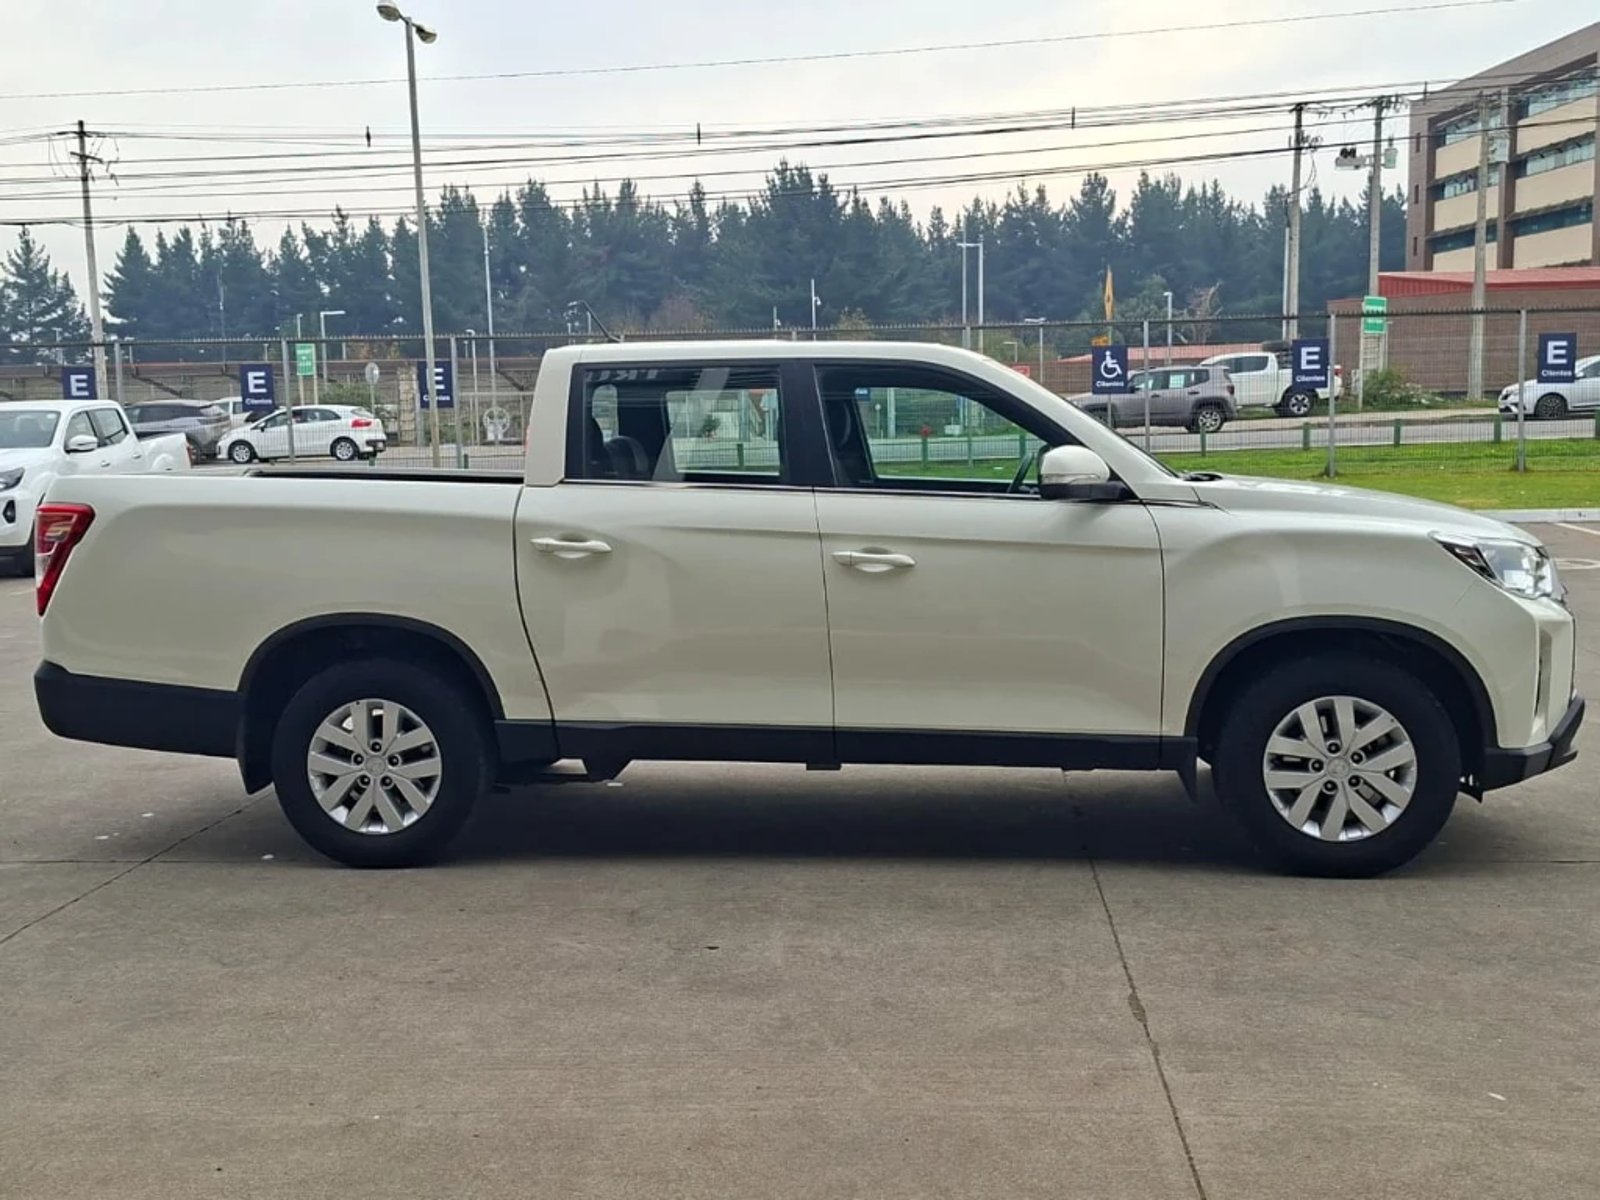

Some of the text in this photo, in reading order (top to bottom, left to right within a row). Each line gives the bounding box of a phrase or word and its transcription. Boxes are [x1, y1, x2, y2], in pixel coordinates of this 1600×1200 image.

[1300, 346, 1320, 370] E
[1547, 340, 1568, 364] E
[247, 371, 267, 393] E
[426, 368, 445, 390] E
[1541, 369, 1572, 377] Clientes
[69, 374, 89, 396] E
